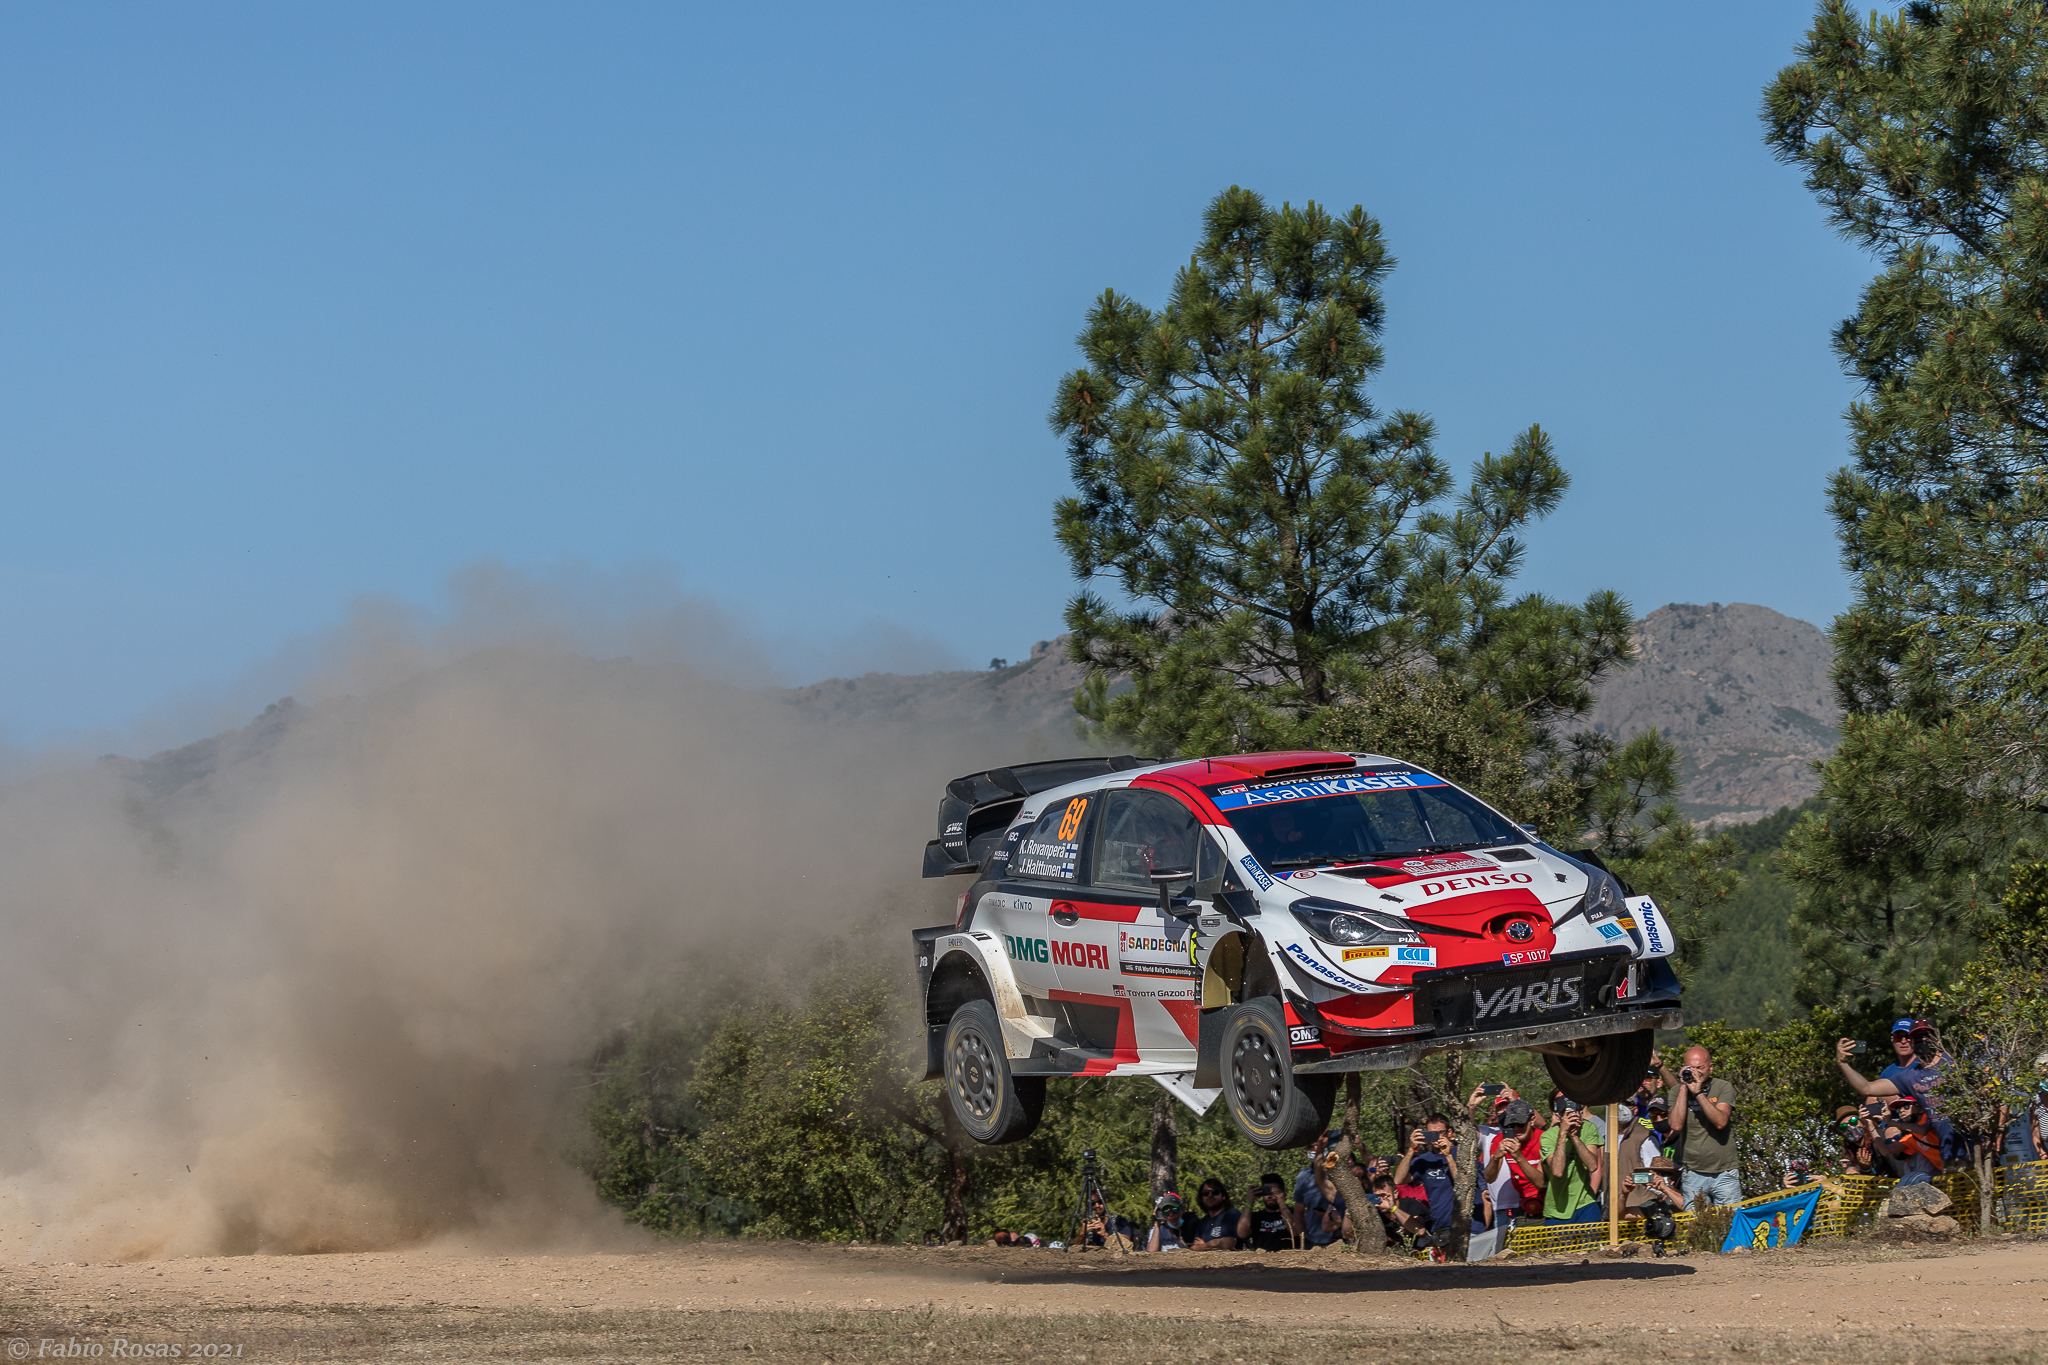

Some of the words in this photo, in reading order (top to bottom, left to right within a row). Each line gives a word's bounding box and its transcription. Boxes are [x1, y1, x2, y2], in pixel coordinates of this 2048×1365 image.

[1245, 775, 1418, 805] AsahiKASEI
[1250, 778, 1307, 790] TOYOTA
[1310, 771, 1361, 782] GAZOO
[1363, 769, 1411, 778] Racing
[1057, 797, 1088, 841] 69
[1019, 839, 1067, 860] K.Rovanperä
[1019, 858, 1062, 878] J.Halttunen
[1241, 856, 1272, 890] AsahiKASEI
[1420, 872, 1533, 897] DENSO
[1638, 901, 1666, 953] Panasonic
[1004, 934, 1049, 963] DMG
[1051, 940, 1110, 970] MORI
[1128, 936, 1188, 953] SARDEGNA
[1344, 948, 1387, 960] PIRELLI
[1285, 943, 1371, 992] Panasonic
[1510, 952, 1524, 964] SP
[1526, 949, 1546, 961] 1017
[1127, 989, 1156, 997] TOYOTA
[1157, 989, 1186, 997] GAZOO
[1290, 1027, 1320, 1042] OMP
